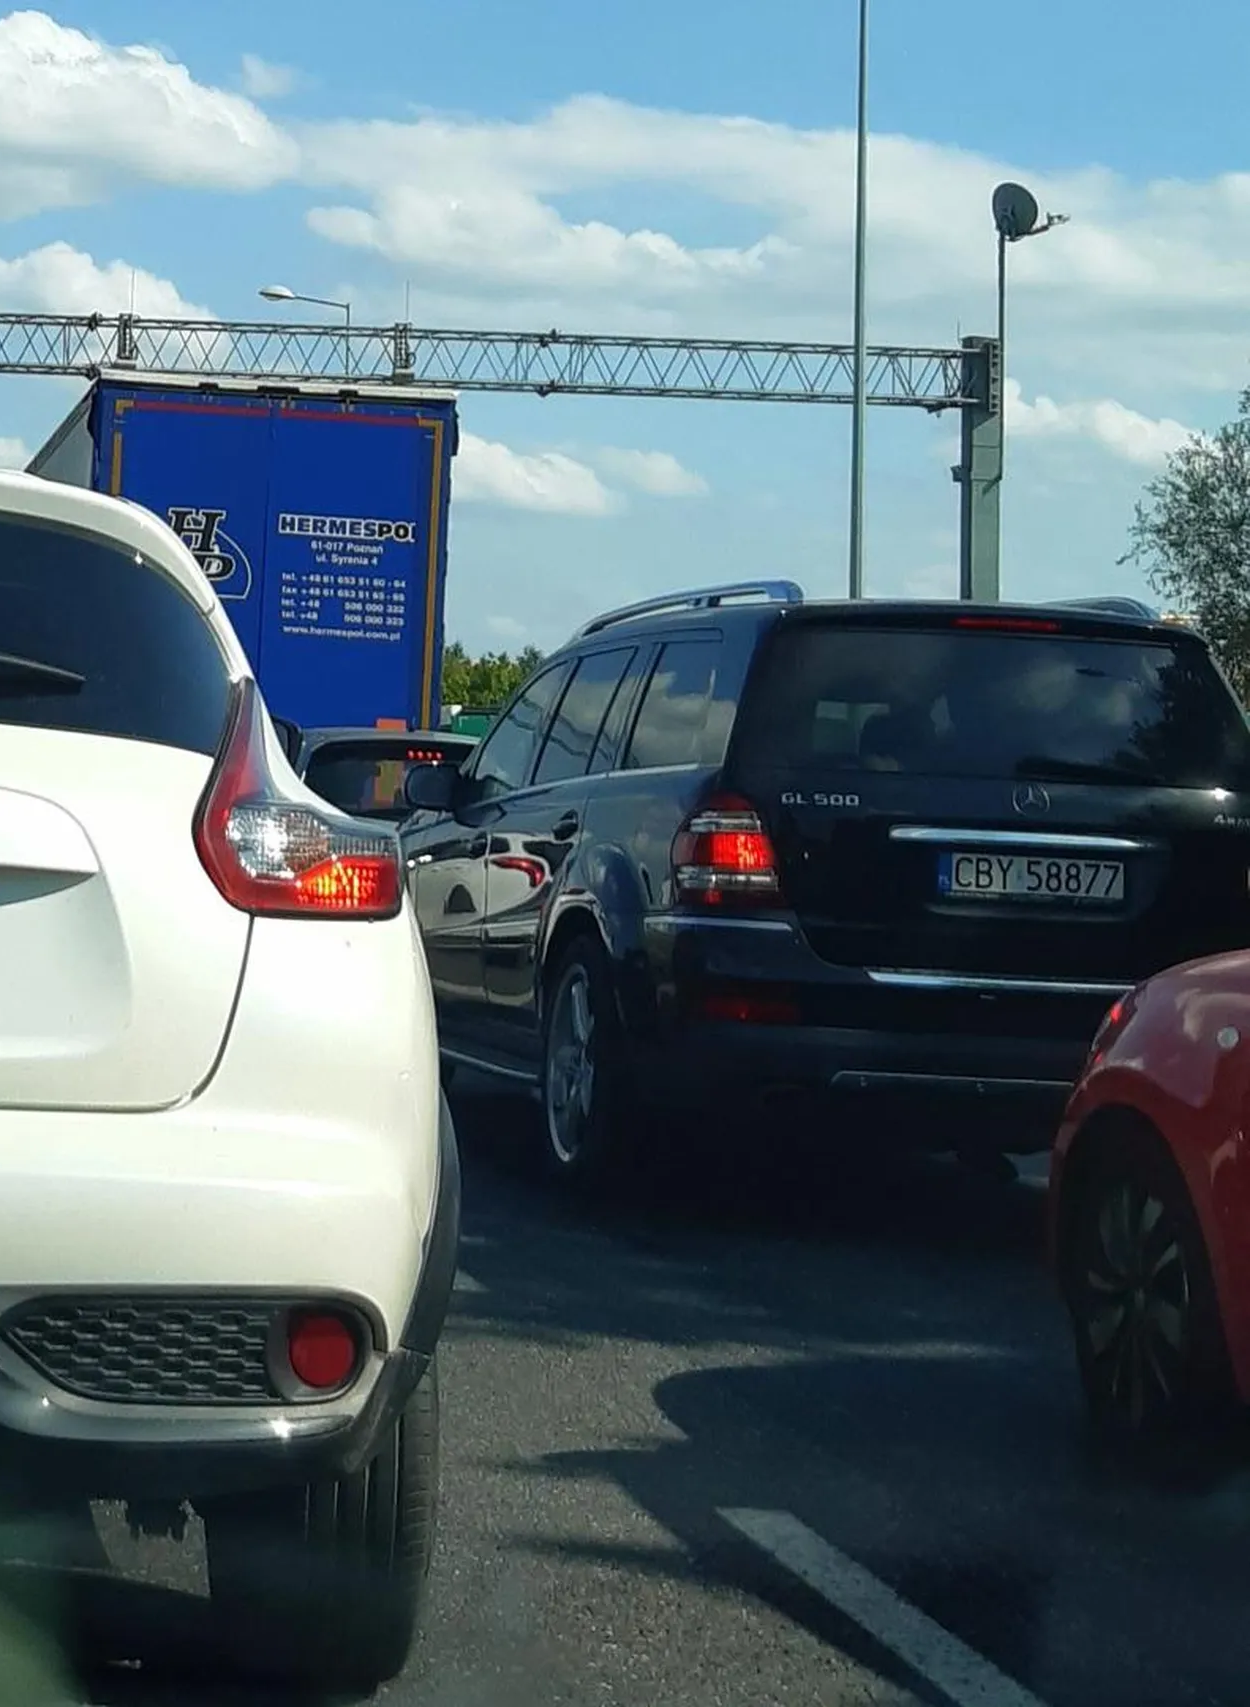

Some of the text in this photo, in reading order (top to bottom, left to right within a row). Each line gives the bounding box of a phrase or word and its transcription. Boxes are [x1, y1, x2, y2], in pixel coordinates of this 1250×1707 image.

[331, 554, 369, 566] Syrenia
[781, 793, 859, 806] GL 500
[955, 857, 1014, 890] CBY
[1026, 859, 1121, 896] 58877
